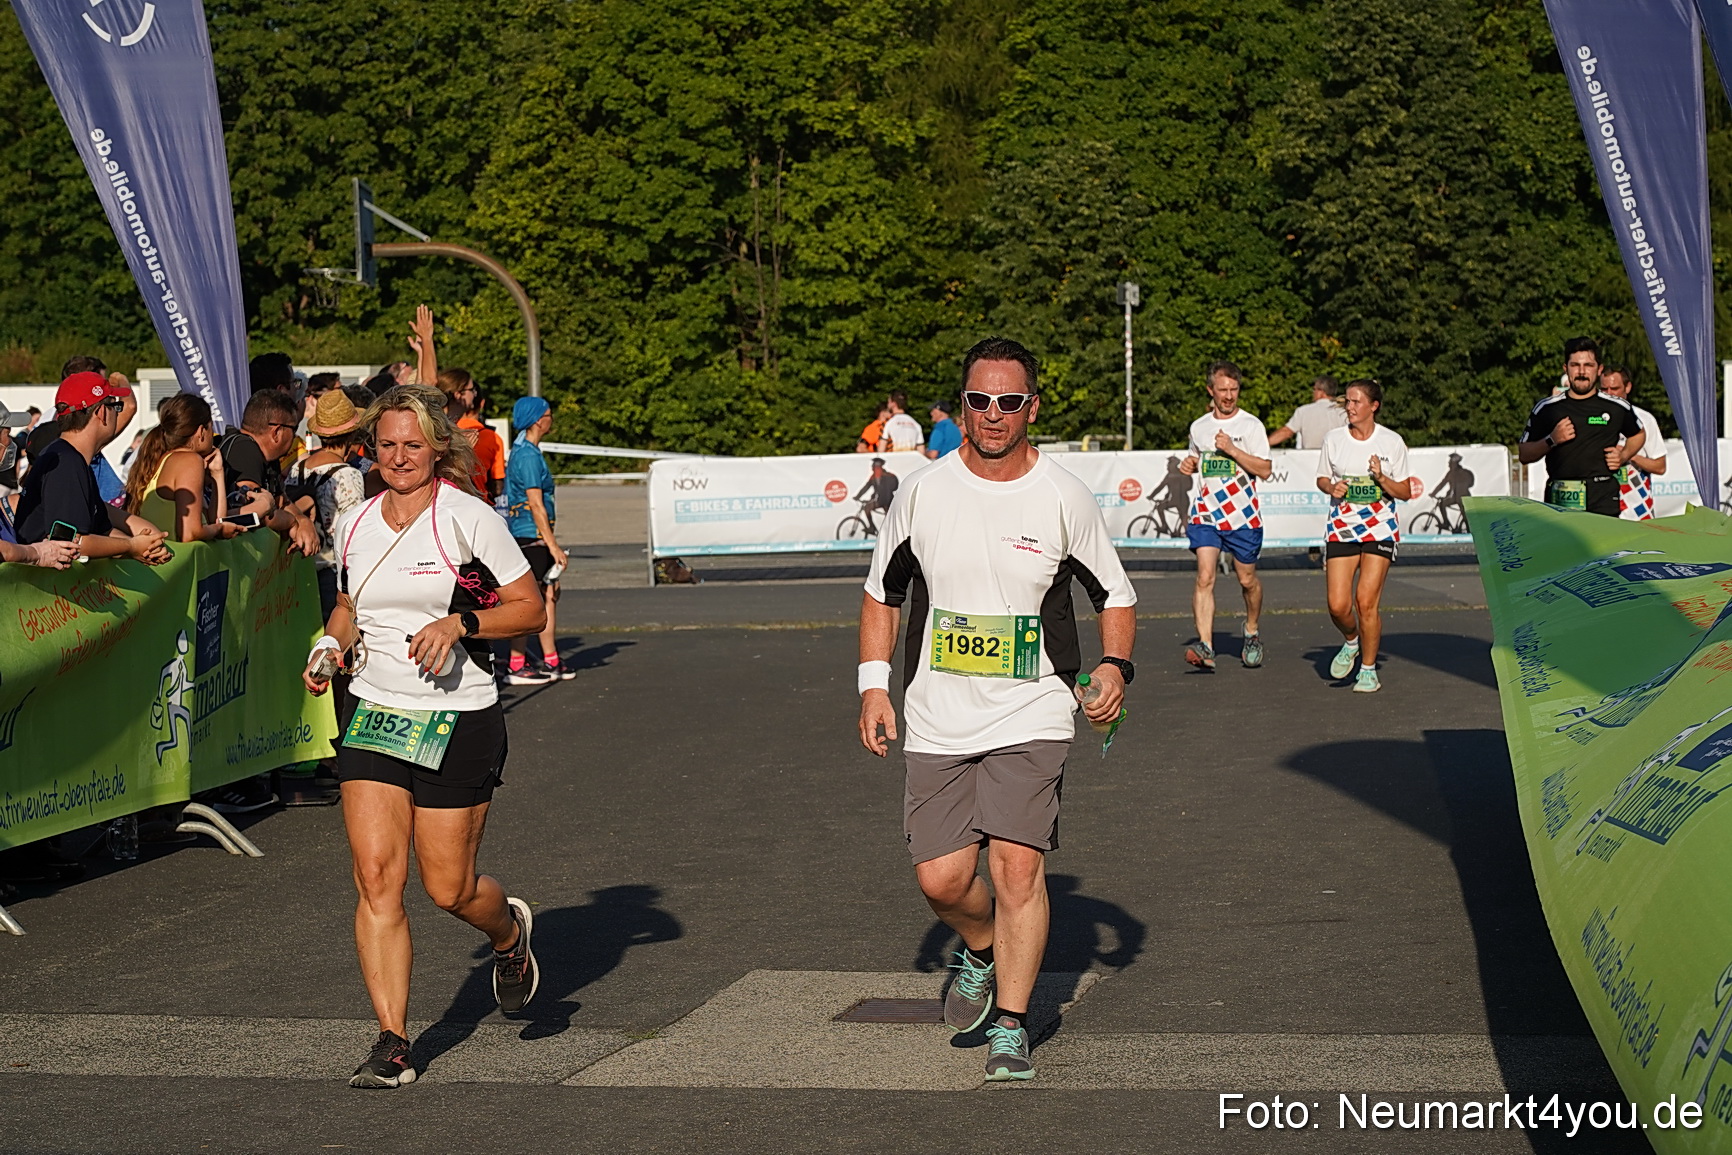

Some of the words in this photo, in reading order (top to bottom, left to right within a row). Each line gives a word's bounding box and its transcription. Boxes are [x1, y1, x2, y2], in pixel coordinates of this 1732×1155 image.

[1207, 460, 1230, 469] 1073
[673, 478, 708, 491] NOW
[1349, 485, 1376, 495] 1065
[676, 500, 729, 513] E-BIKES
[731, 499, 742, 511] &
[746, 495, 827, 510] FAHRRÄDER
[18, 584, 78, 642] Gesunde
[201, 603, 220, 626] Fischer
[935, 633, 943, 662] WALK
[944, 632, 1000, 657] 1982
[1002, 640, 1010, 668] 2022
[350, 715, 364, 736] RUN
[365, 711, 412, 738] 1952
[374, 732, 406, 748] Susanne
[406, 724, 422, 752] 2022
